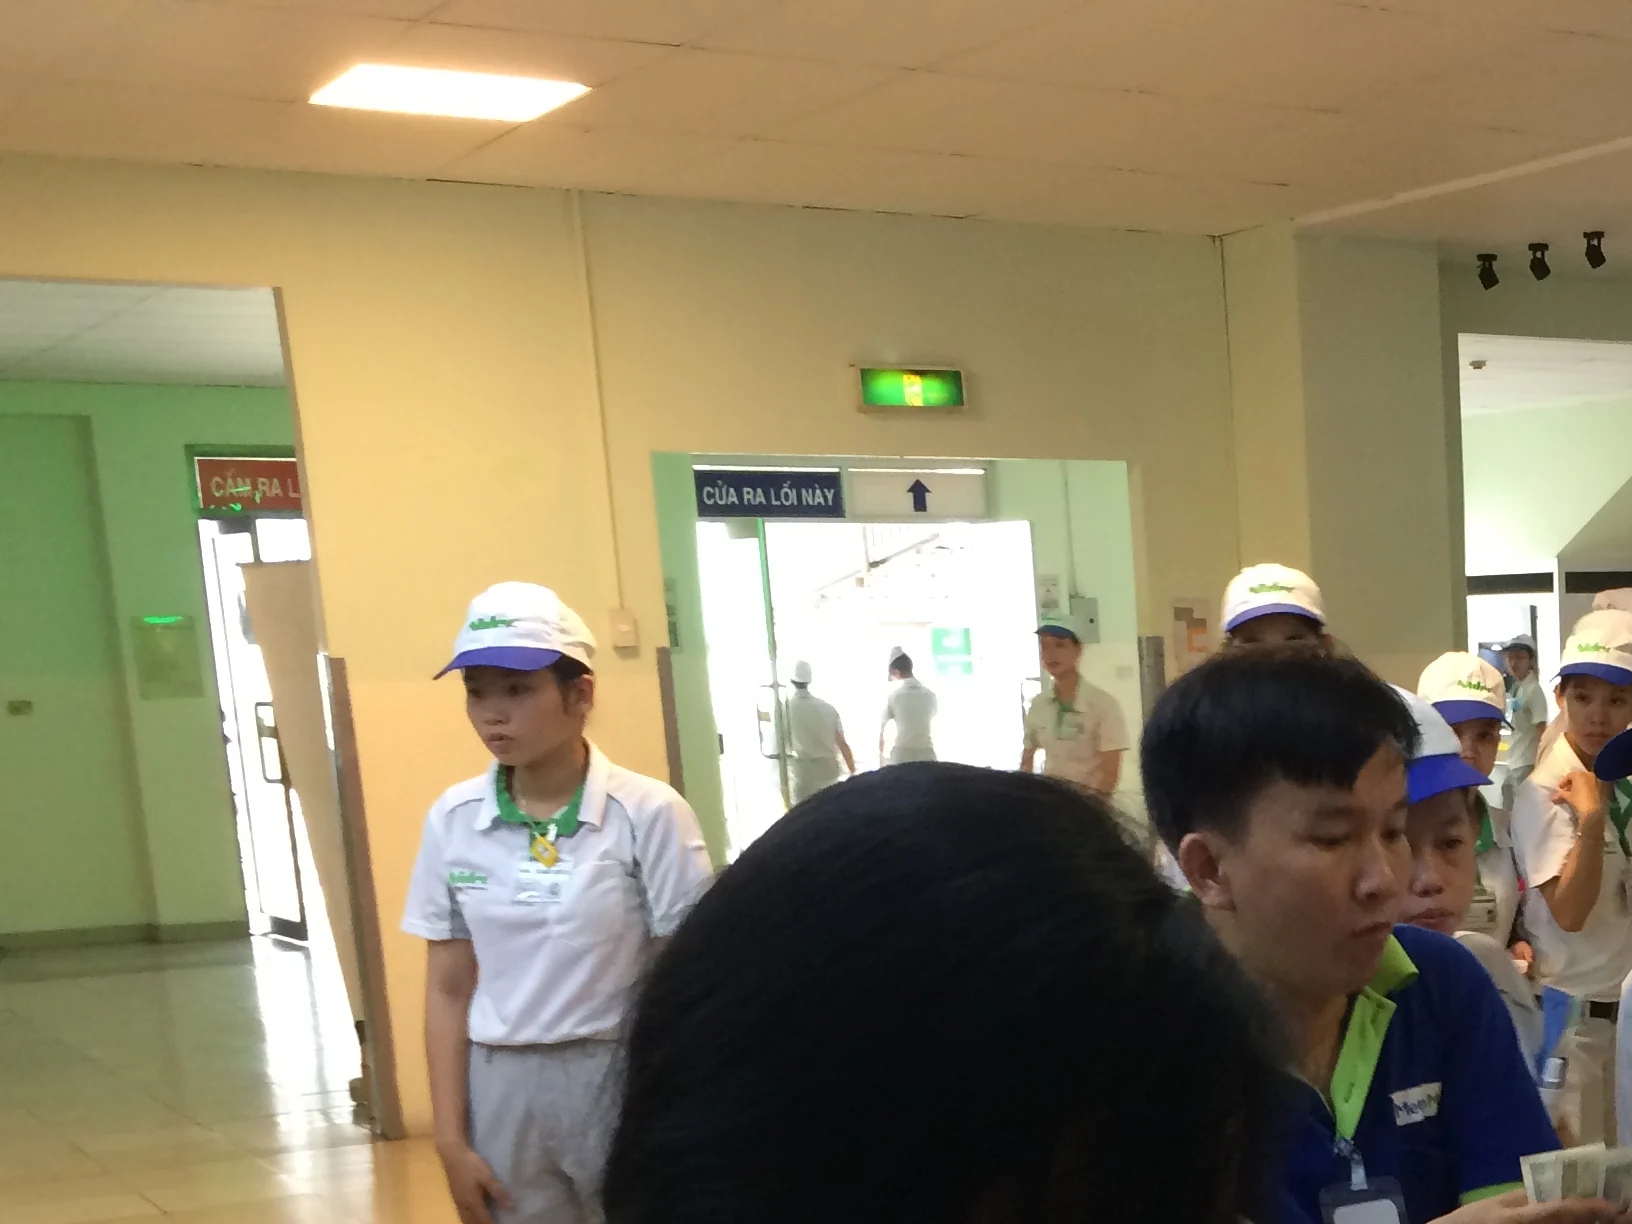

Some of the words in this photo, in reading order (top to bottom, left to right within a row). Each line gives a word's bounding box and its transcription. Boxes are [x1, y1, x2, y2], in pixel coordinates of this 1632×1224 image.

[257, 477, 283, 498] RA
[702, 479, 739, 505] CỬA
[743, 487, 767, 505] RA
[770, 480, 798, 505] LỐI
[801, 483, 835, 506] NÀY
